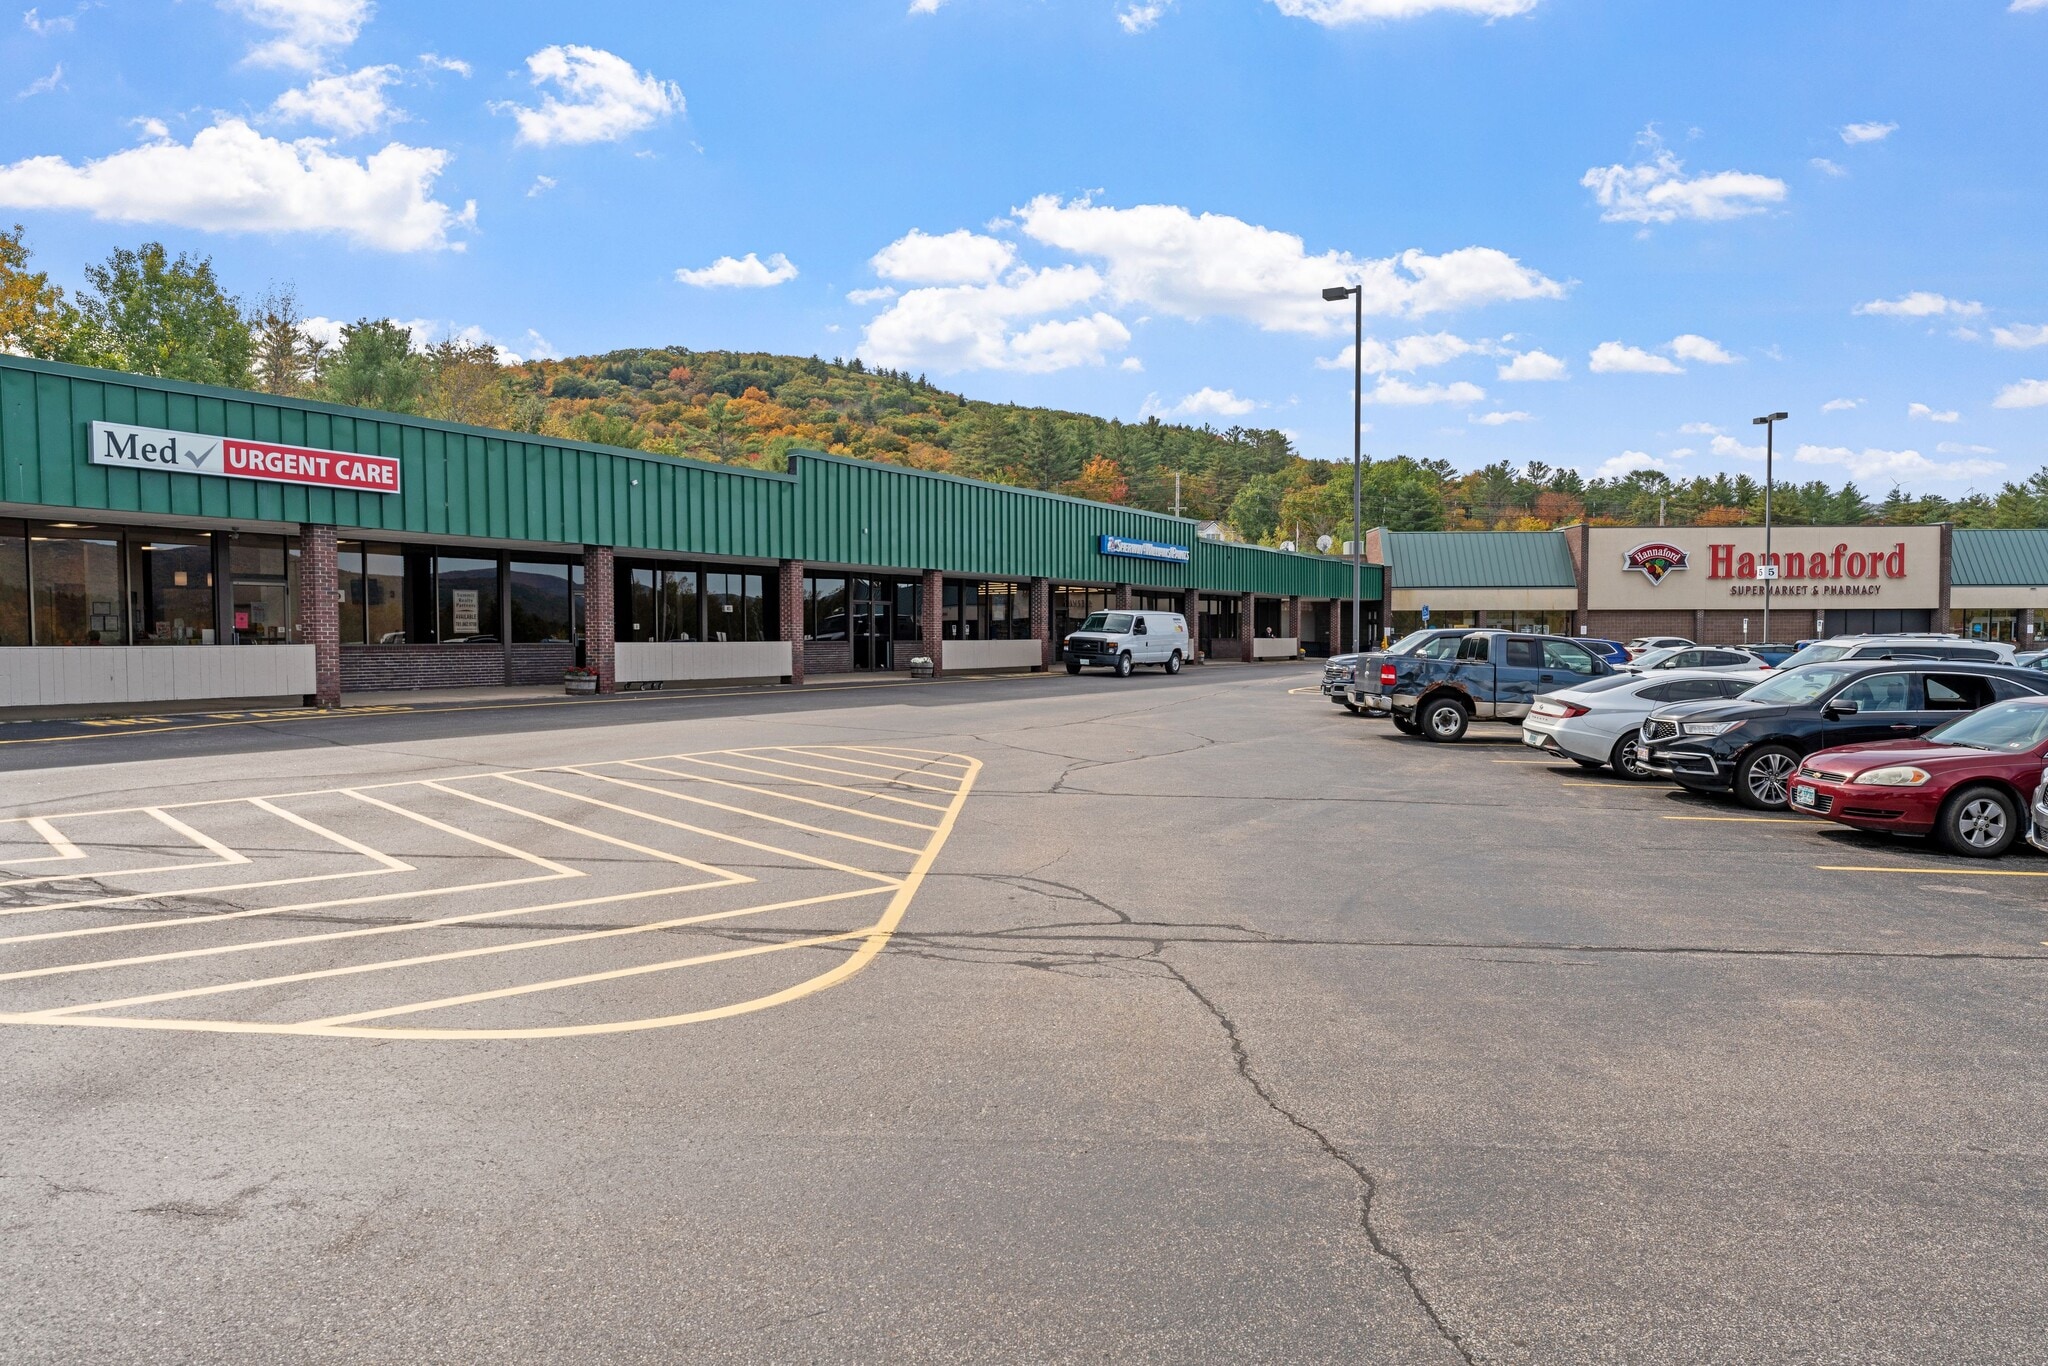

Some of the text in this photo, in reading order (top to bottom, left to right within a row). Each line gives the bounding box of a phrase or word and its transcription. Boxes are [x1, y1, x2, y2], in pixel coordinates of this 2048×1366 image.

[103, 430, 394, 485] Med URGENT CARE
[1634, 548, 1681, 562] Hannaford
[1768, 568, 1774, 576] 5
[1731, 585, 1882, 595] SUPERMARKET & PHARMACY
